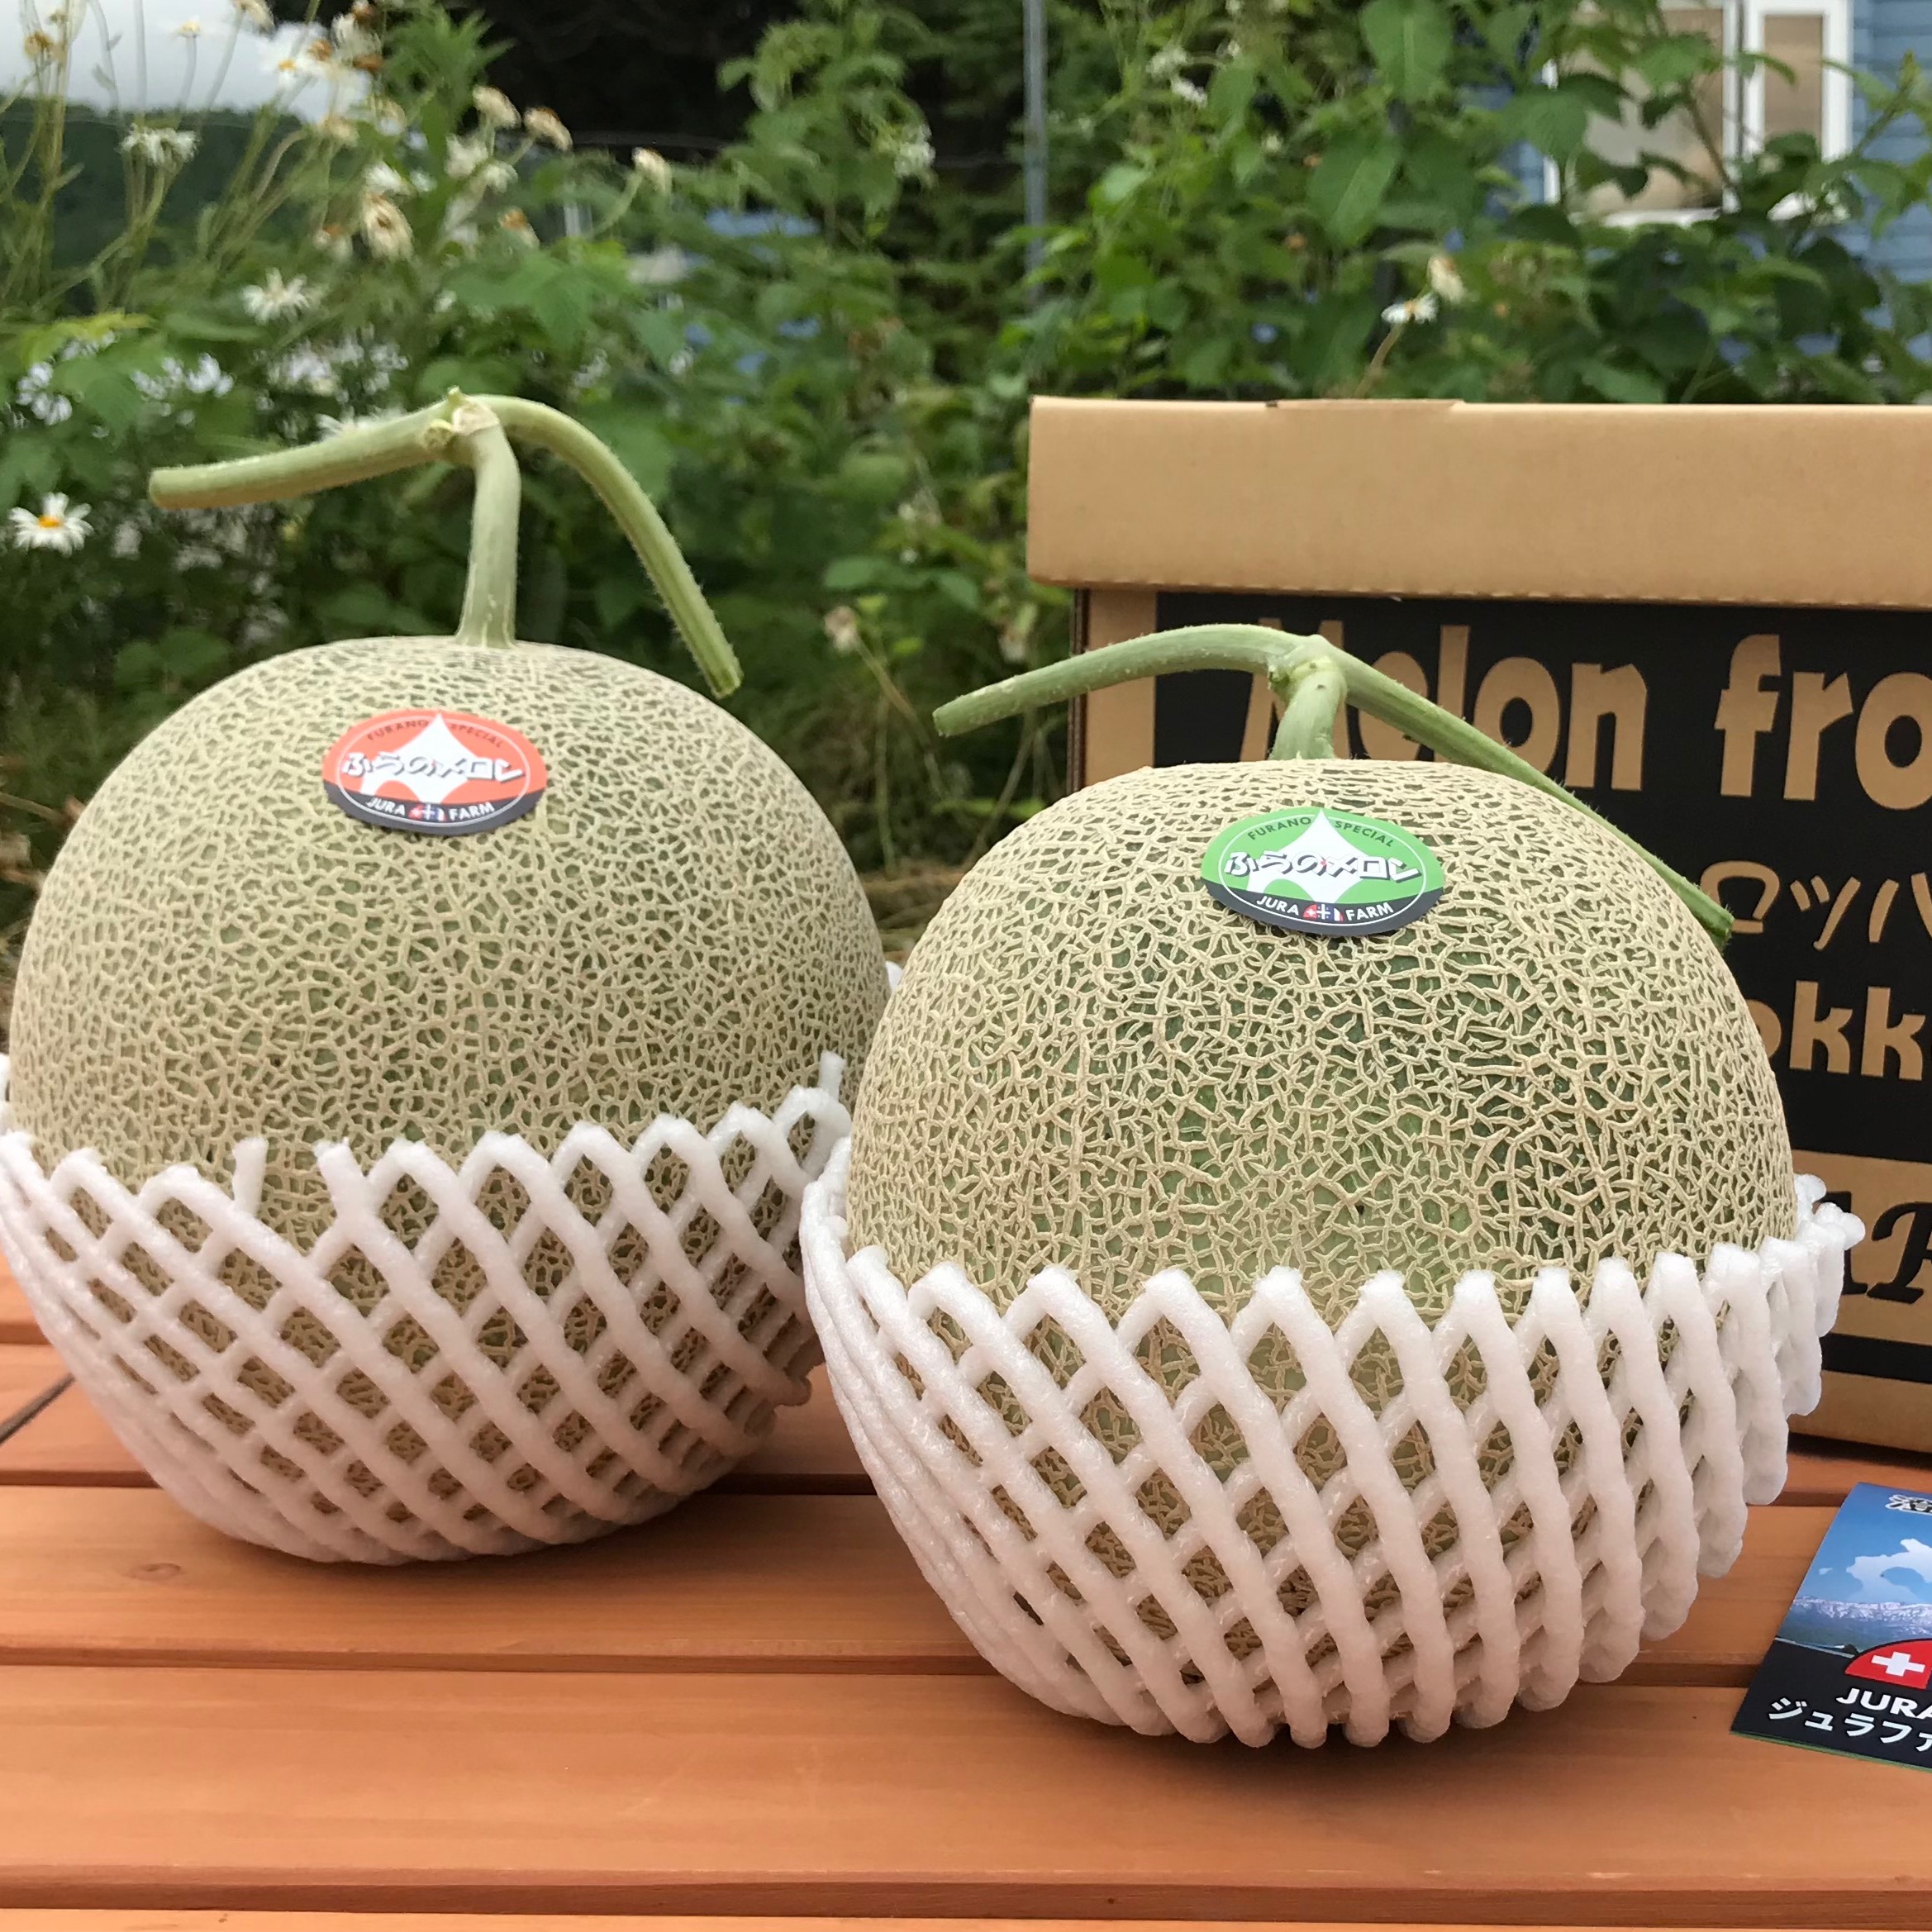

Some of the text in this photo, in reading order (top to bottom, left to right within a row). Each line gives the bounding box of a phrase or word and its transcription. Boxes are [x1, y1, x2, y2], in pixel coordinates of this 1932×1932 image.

[364, 797, 495, 821] JURA FARM
[1247, 816, 1395, 848] FURANO SPECIAL
[1256, 894, 1394, 921] JURA FARM
